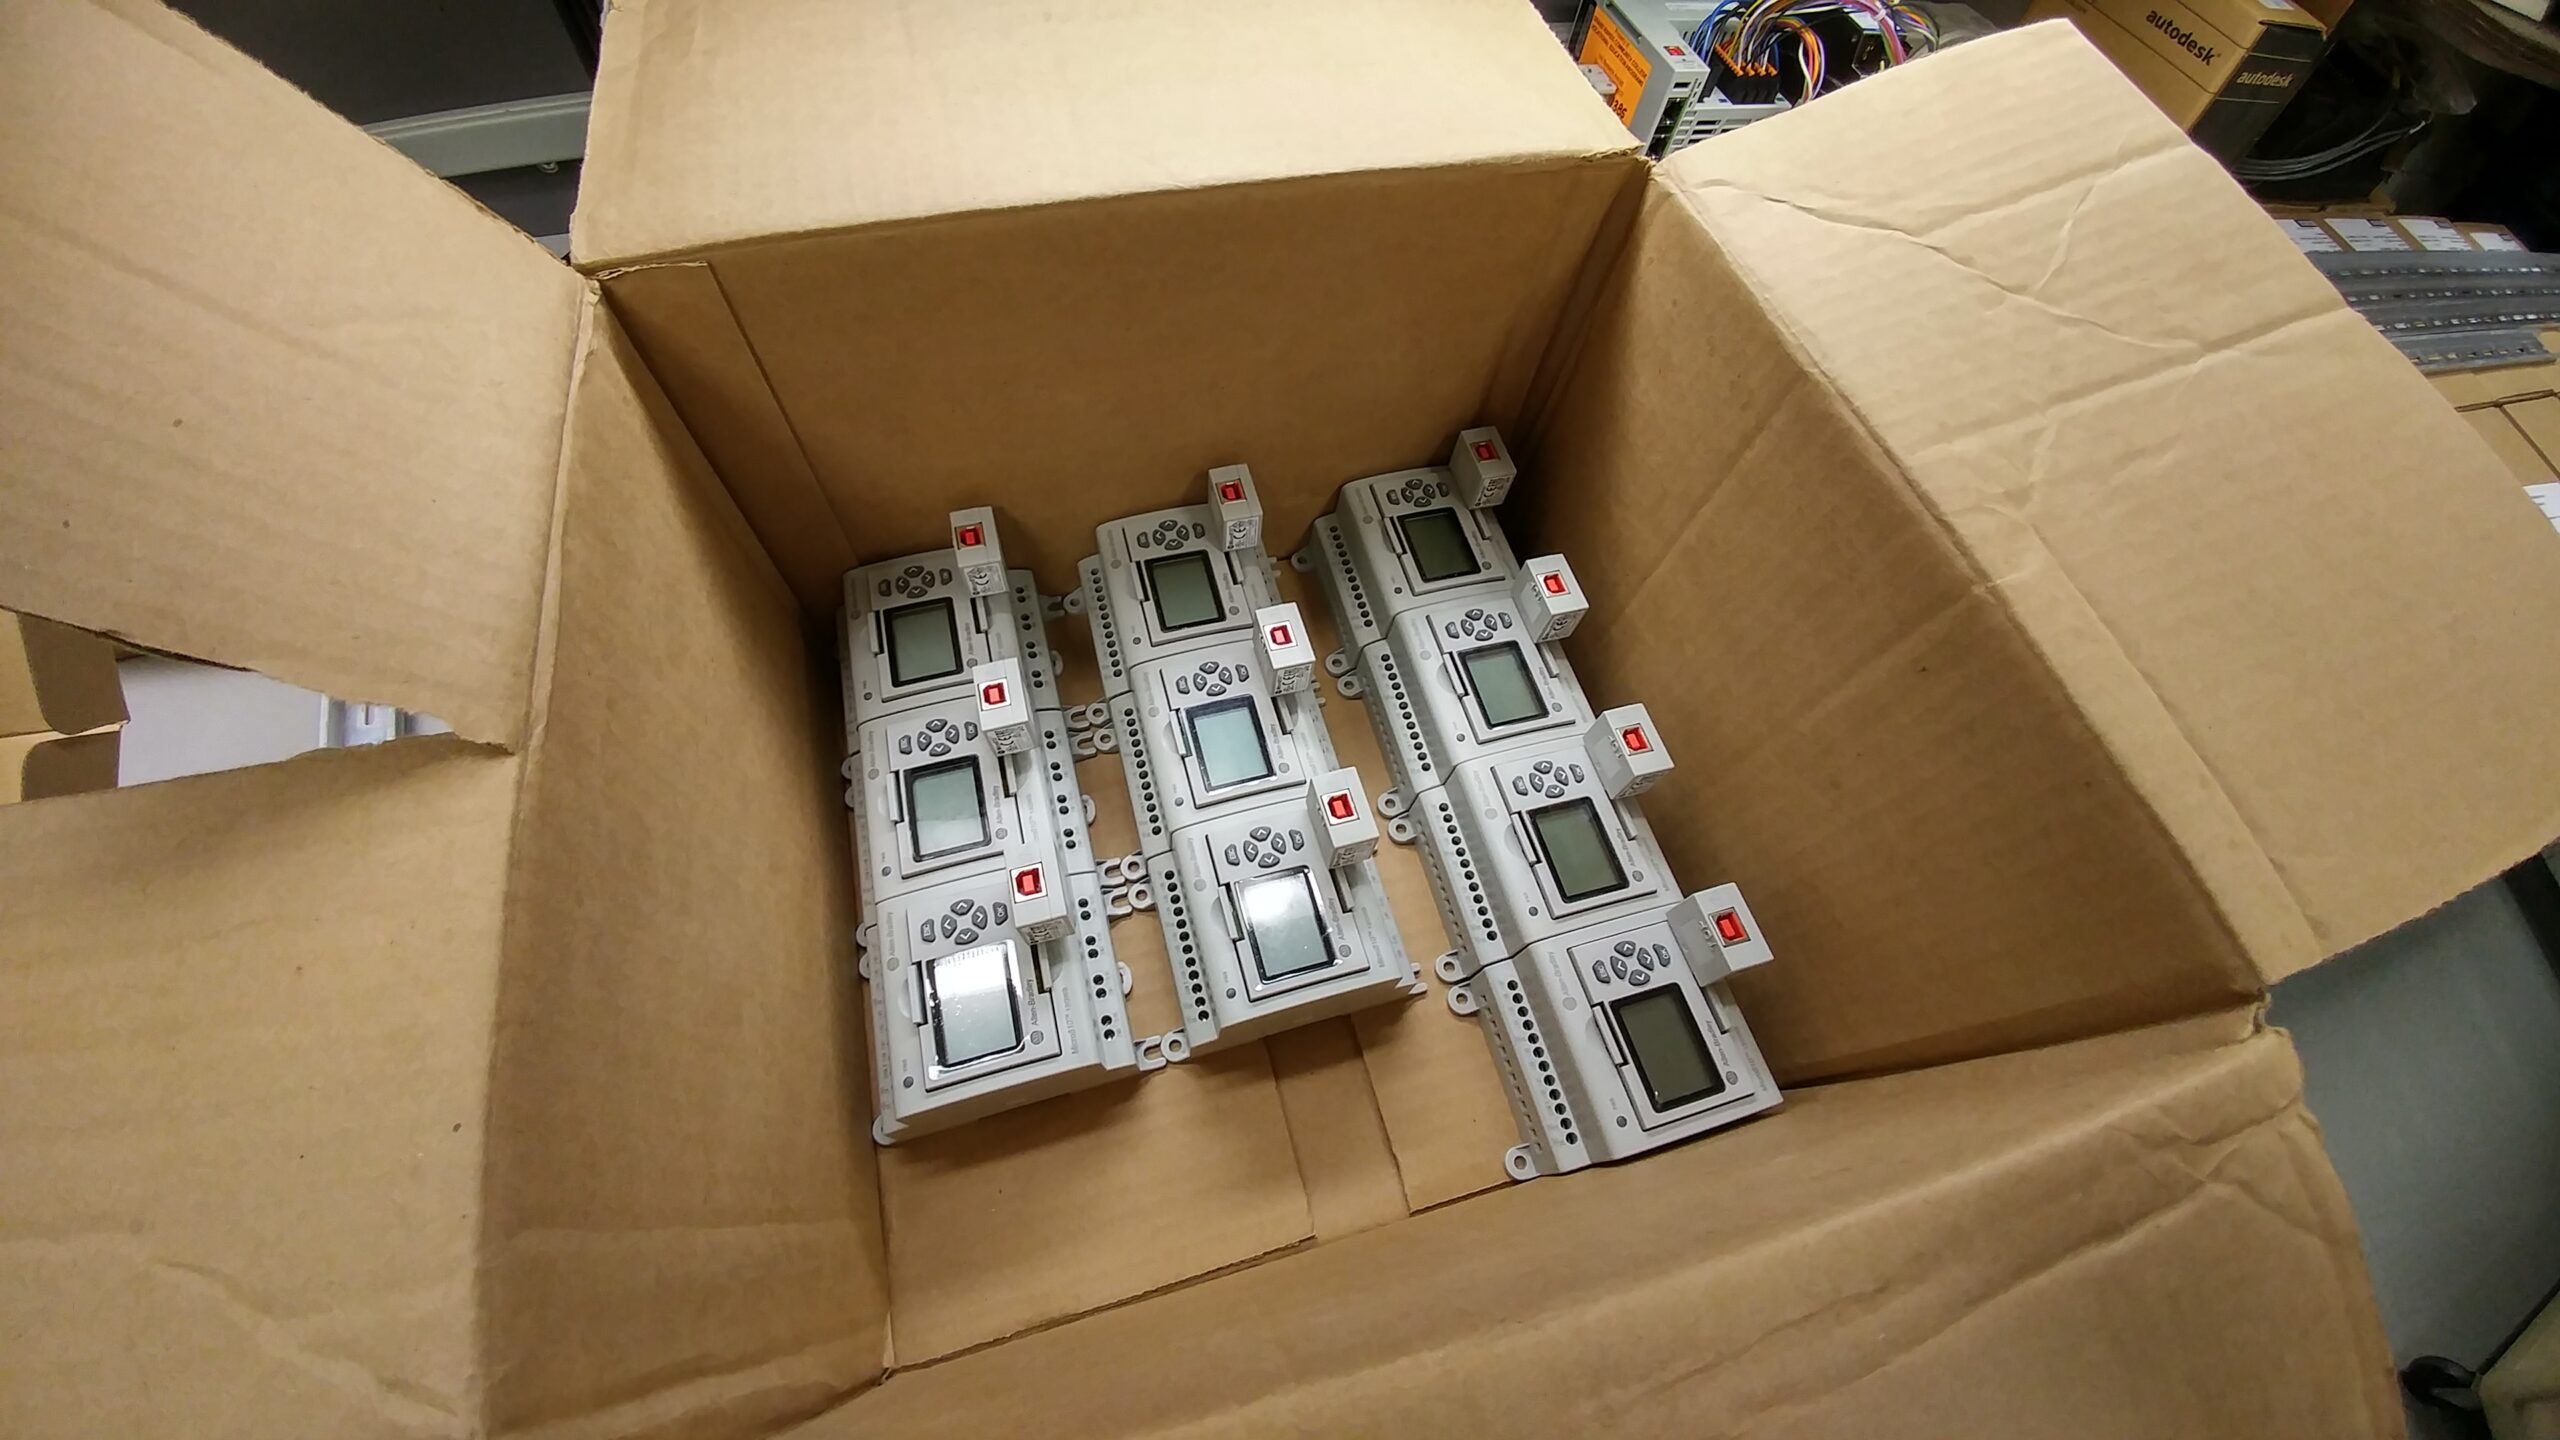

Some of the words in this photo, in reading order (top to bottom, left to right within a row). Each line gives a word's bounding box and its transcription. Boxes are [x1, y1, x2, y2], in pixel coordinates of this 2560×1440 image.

[1609, 44, 1626, 67] EDUCATION
[1614, 39, 1633, 61] COMMUNITY
[1632, 59, 1647, 78] COLLEGE
[2145, 10, 2215, 66] autodesk
[2237, 71, 2294, 87] autodesk
[1026, 978, 1039, 1026] Allen-Bradley
[1706, 1020, 1729, 1067] Allen-Bradley
